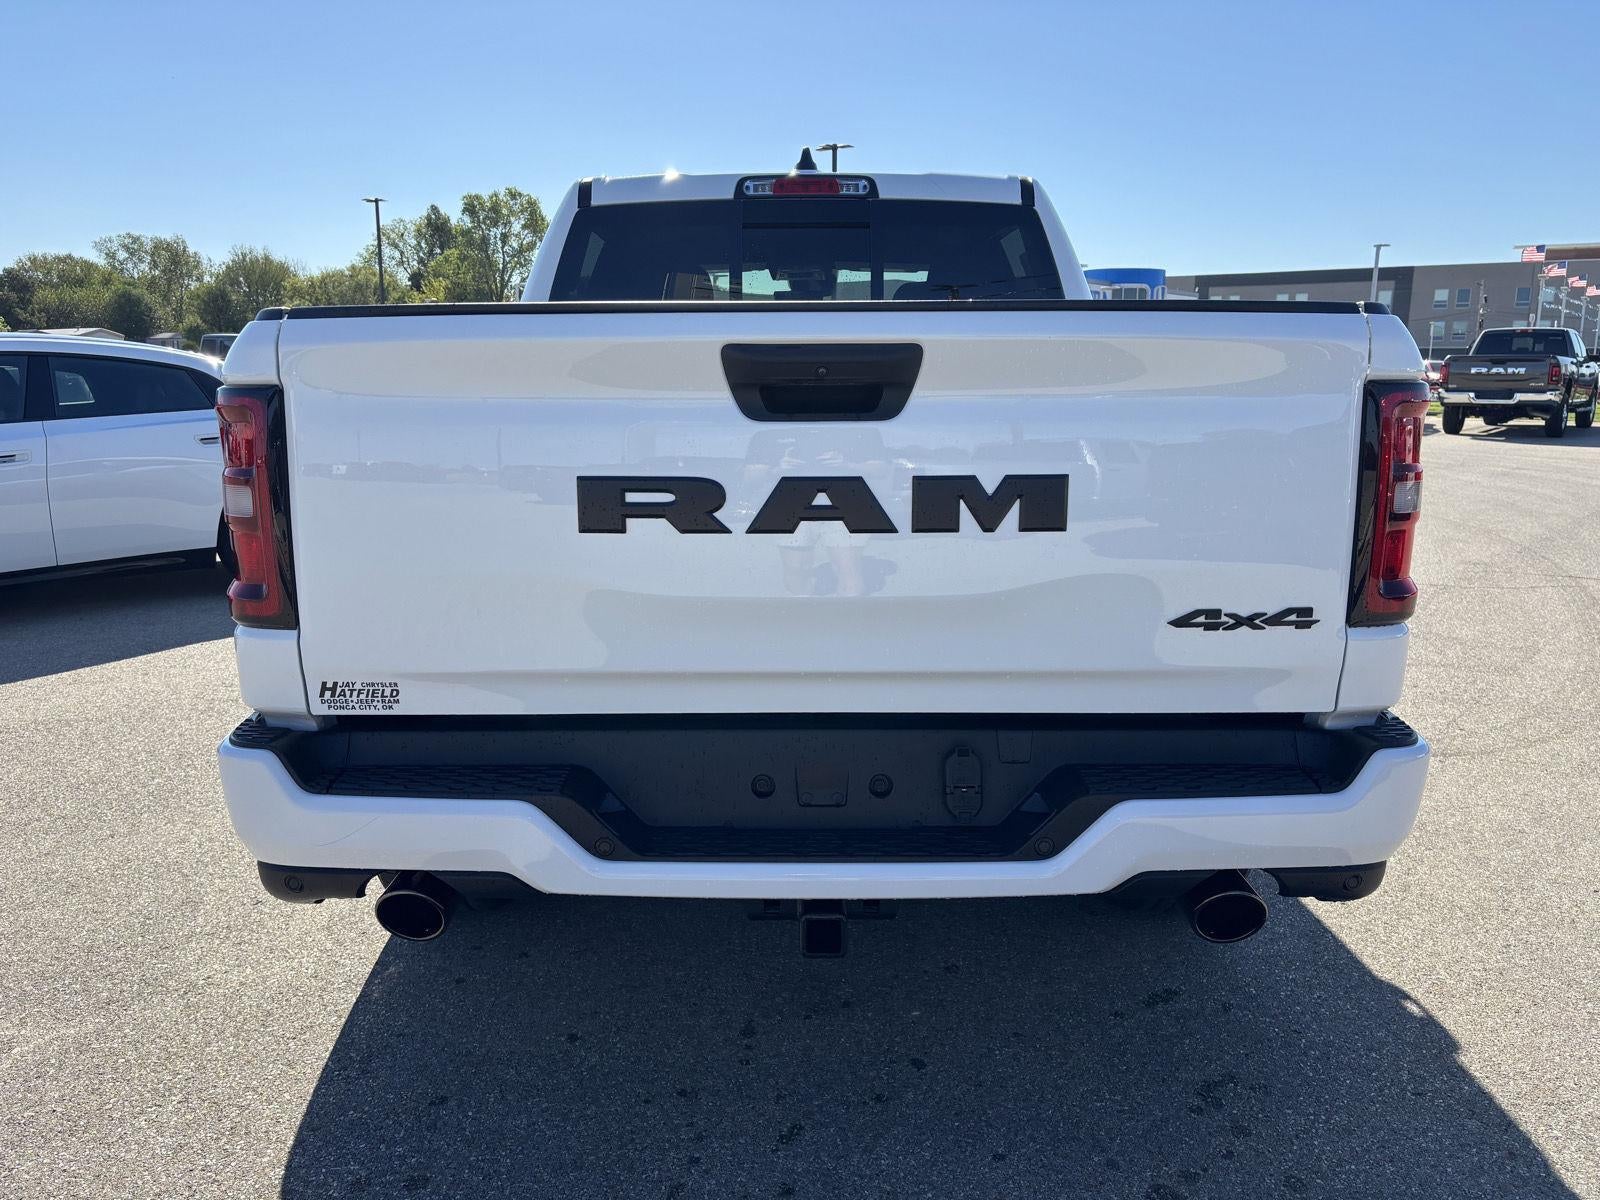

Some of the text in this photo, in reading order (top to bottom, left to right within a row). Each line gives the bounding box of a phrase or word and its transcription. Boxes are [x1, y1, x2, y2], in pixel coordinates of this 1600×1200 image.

[1470, 367, 1527, 375] RAM
[577, 474, 1070, 534] RAM
[319, 681, 400, 698] HATFIELD
